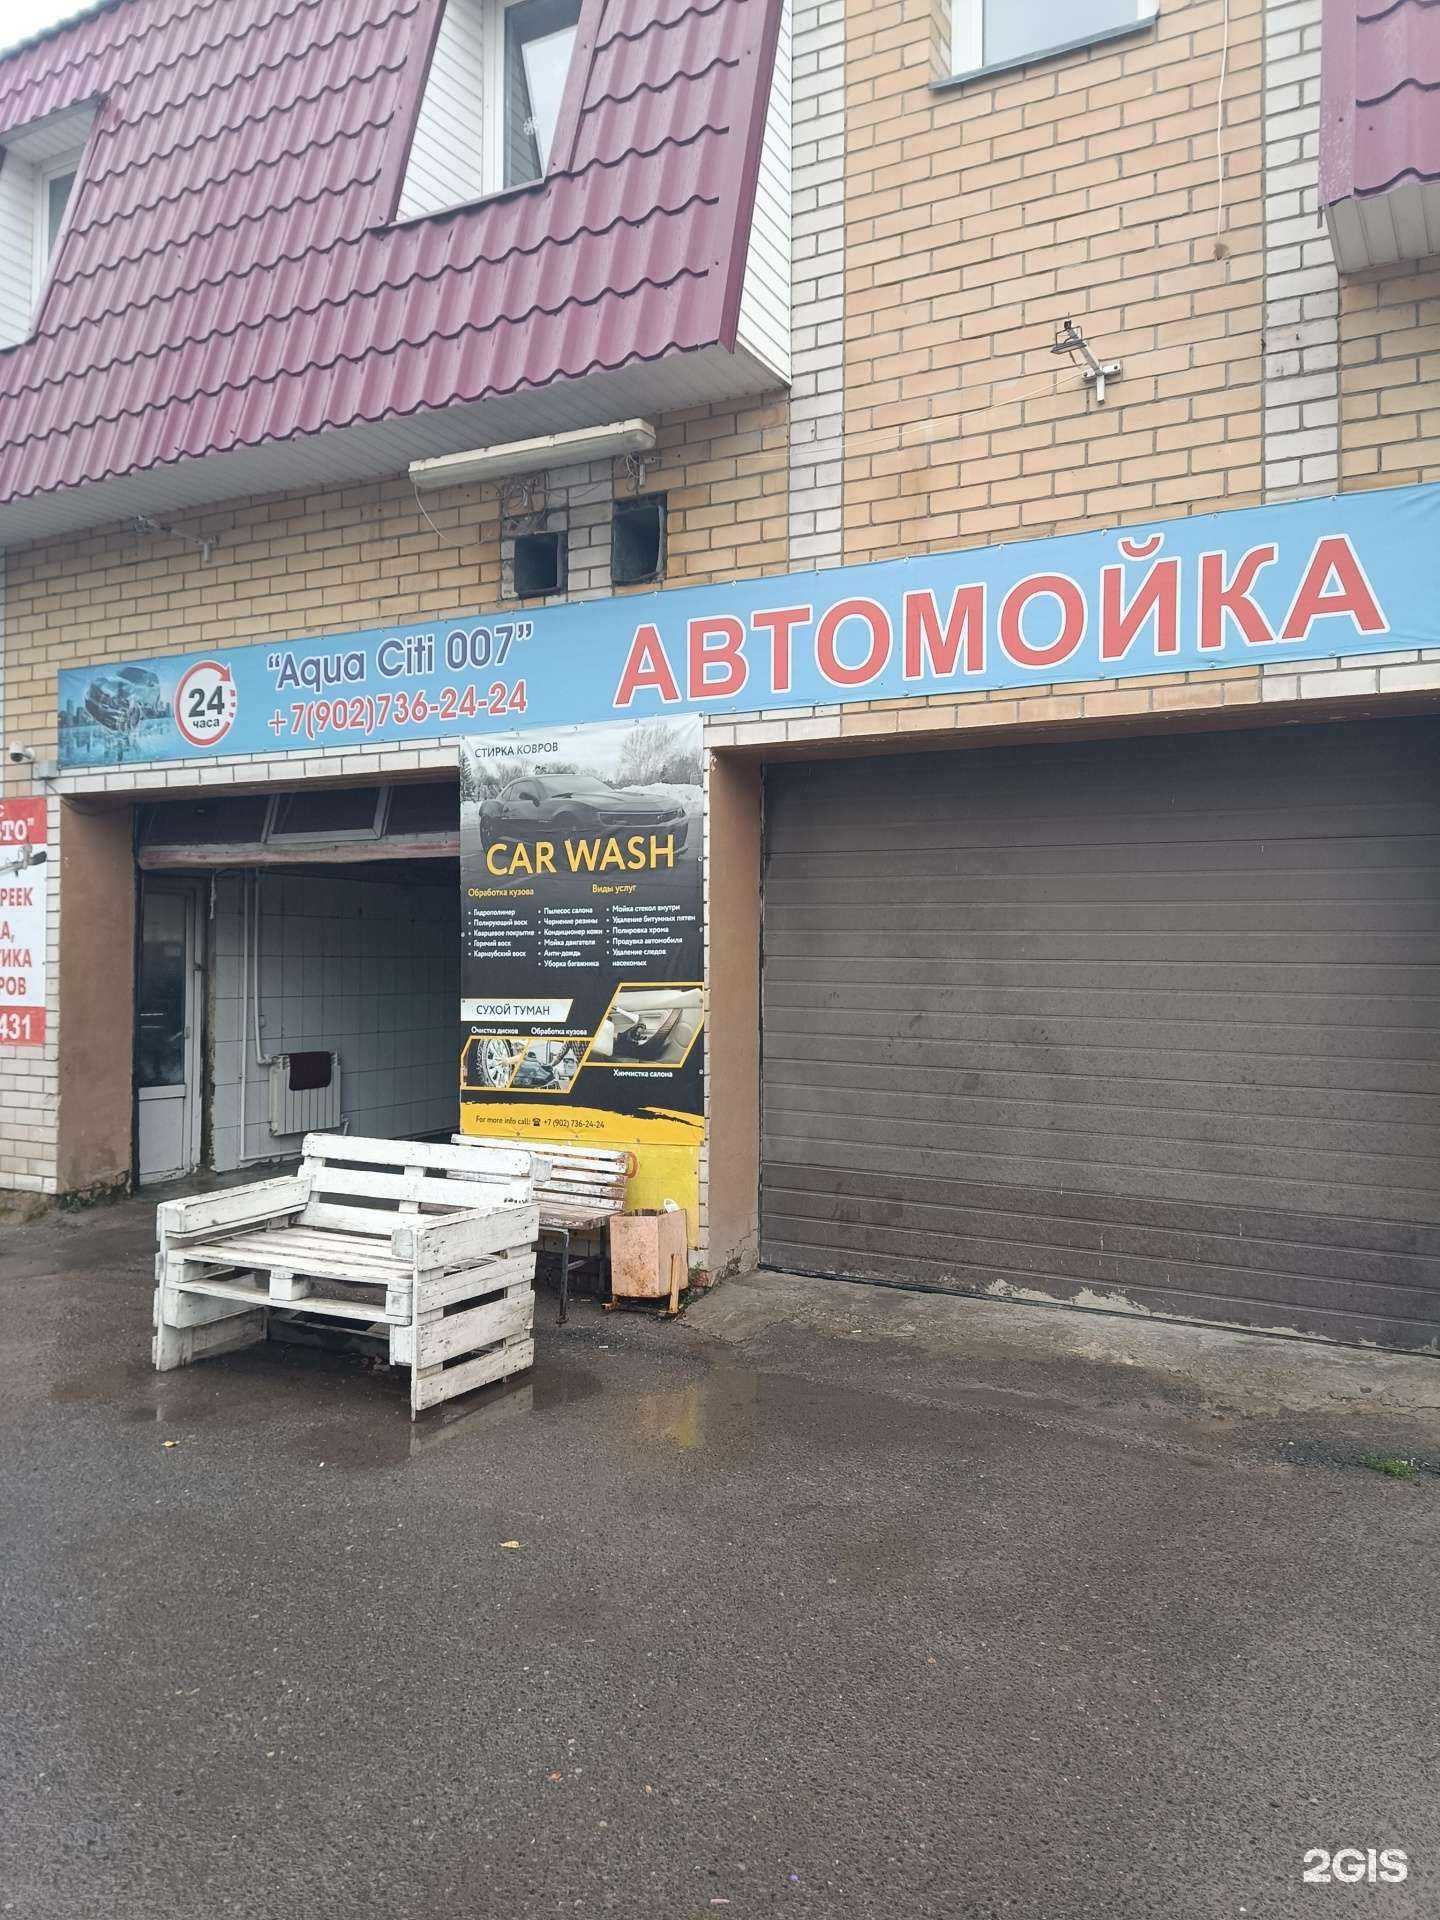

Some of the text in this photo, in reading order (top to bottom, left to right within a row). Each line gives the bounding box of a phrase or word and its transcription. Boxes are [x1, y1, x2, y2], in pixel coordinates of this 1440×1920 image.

[613, 534, 1388, 707] АВТОМОЙКА
[377, 635, 435, 677] Citi
[188, 685, 225, 718] 24
[269, 680, 528, 739] +7(902)736-24-24
[192, 718, 220, 729] часа
[474, 742, 559, 758] СТИРКА КОВРОВ
[0, 817, 34, 841] ТО"
[486, 833, 675, 876] CAR WASH
[467, 888, 534, 898] Обработка кузова
[592, 883, 637, 893] Виды услуг
[0, 887, 33, 906] РЕЕК
[473, 909, 516, 917] Гидрополимер
[657, 904, 681, 912] внутри
[473, 919, 513, 927] Полирующий
[543, 918, 598, 926] Чернение резины
[612, 914, 696, 924] Удаление битумных пятен
[473, 929, 505, 937] Кварцевое
[543, 928, 586, 936] Кондиционер
[612, 926, 669, 935] Полировка хрома
[612, 936, 683, 946] Продувка автомобиля
[473, 950, 512, 958] Карнаубский
[543, 949, 581, 957] Анти-дождь
[612, 948, 643, 956] Удаление
[0, 949, 32, 967] ИКА
[543, 960, 566, 968] Уборка
[476, 1003, 550, 1015] СУХОЙ ТУМАН
[0, 1013, 31, 1040] 431
[470, 1026, 496, 1034] Очистка
[530, 1026, 588, 1036] Обработка кузова
[613, 1068, 649, 1078] Химчистка
[476, 1115, 486, 1123] For
[504, 1116, 517, 1124] info
[543, 1118, 552, 1126] +7
[552, 1118, 570, 1128] (902)
[571, 1119, 605, 1129] 736-24-24
